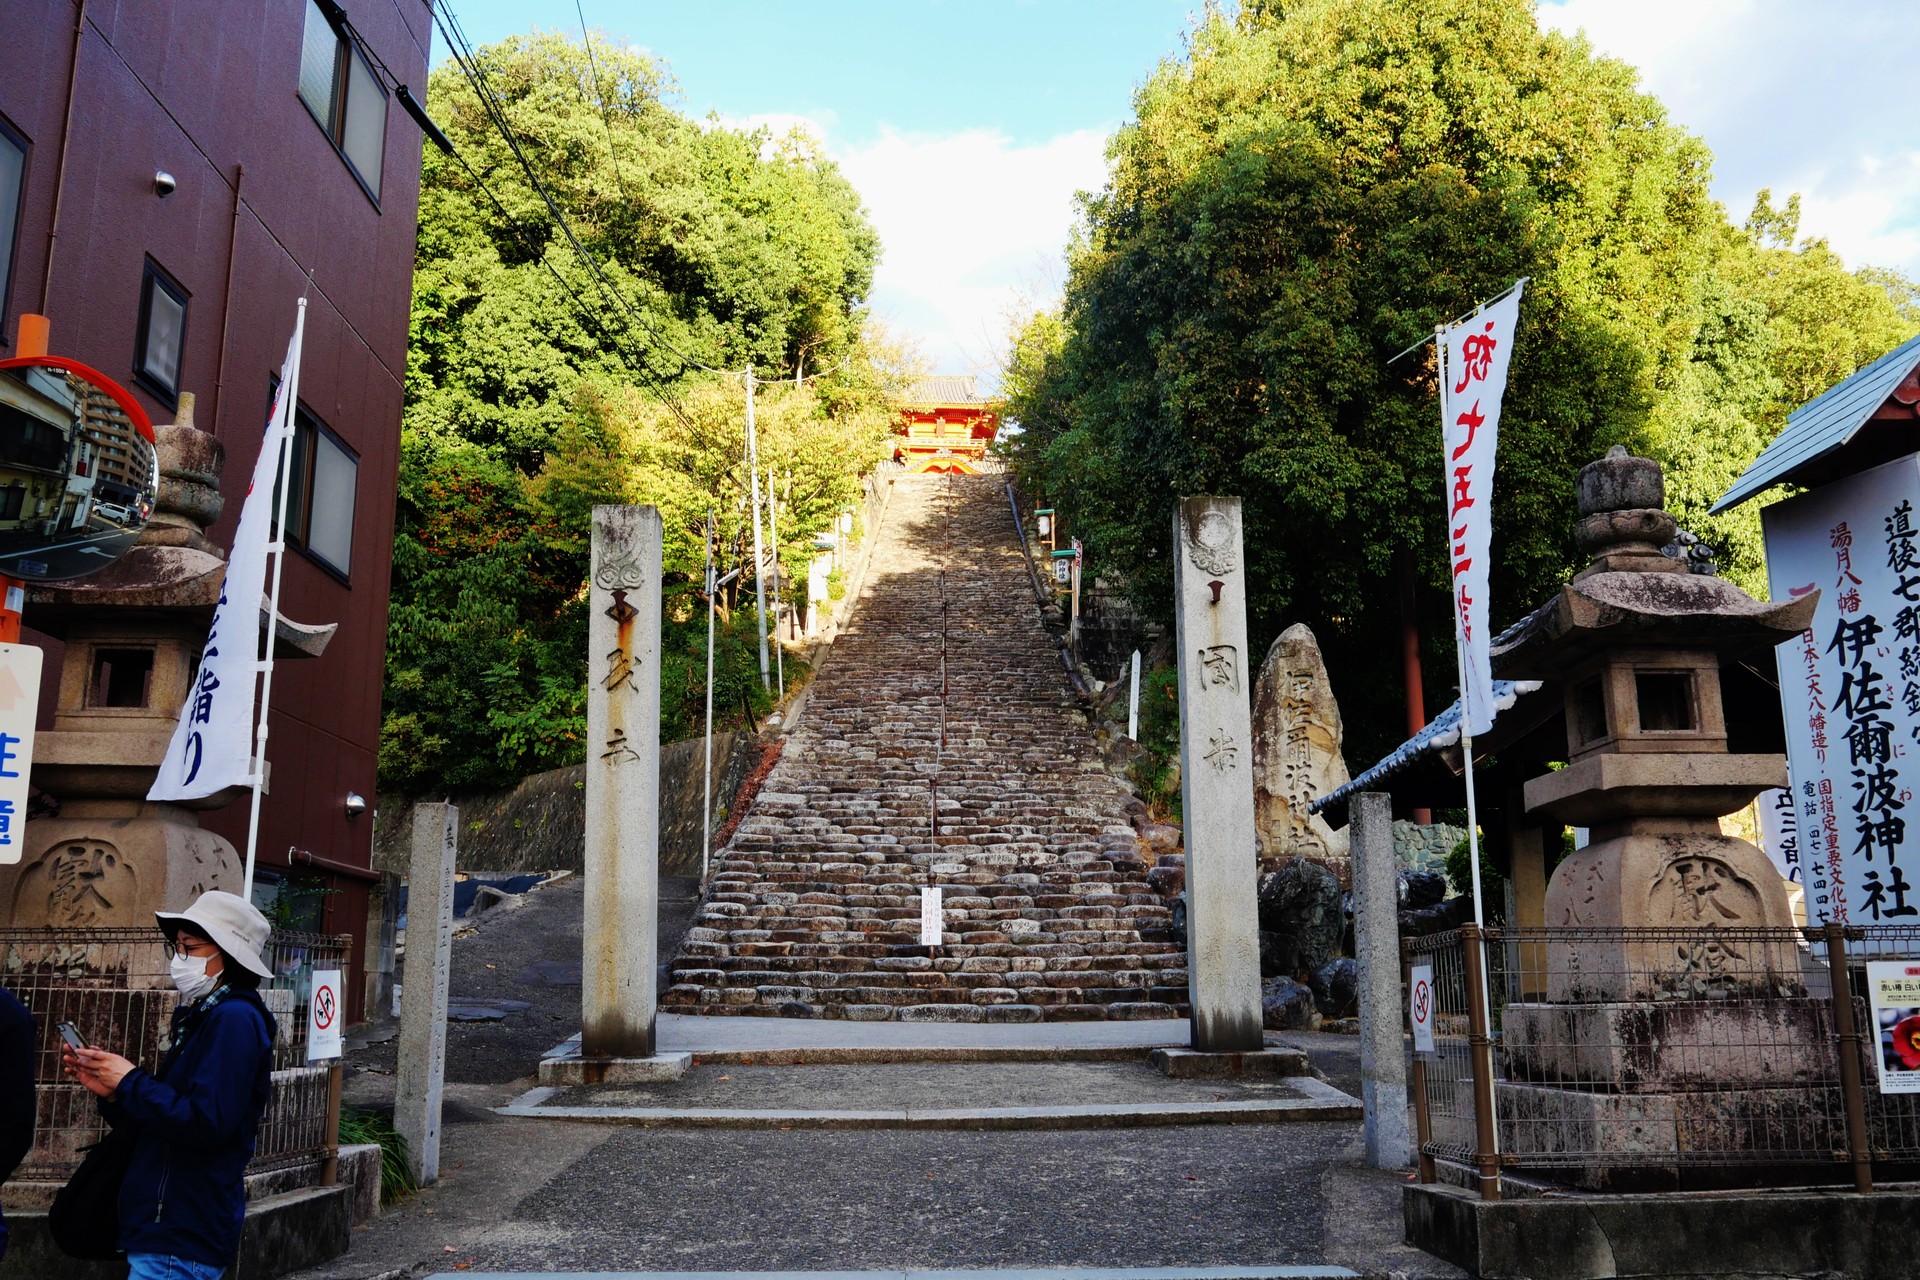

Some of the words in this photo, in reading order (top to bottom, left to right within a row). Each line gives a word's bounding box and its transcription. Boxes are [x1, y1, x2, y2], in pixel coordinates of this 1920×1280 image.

[1829, 522, 1863, 615] 湯月八幡
[1826, 614, 1918, 920] 伊佐爾波神社
[1905, 984, 1920, 992] 白い
